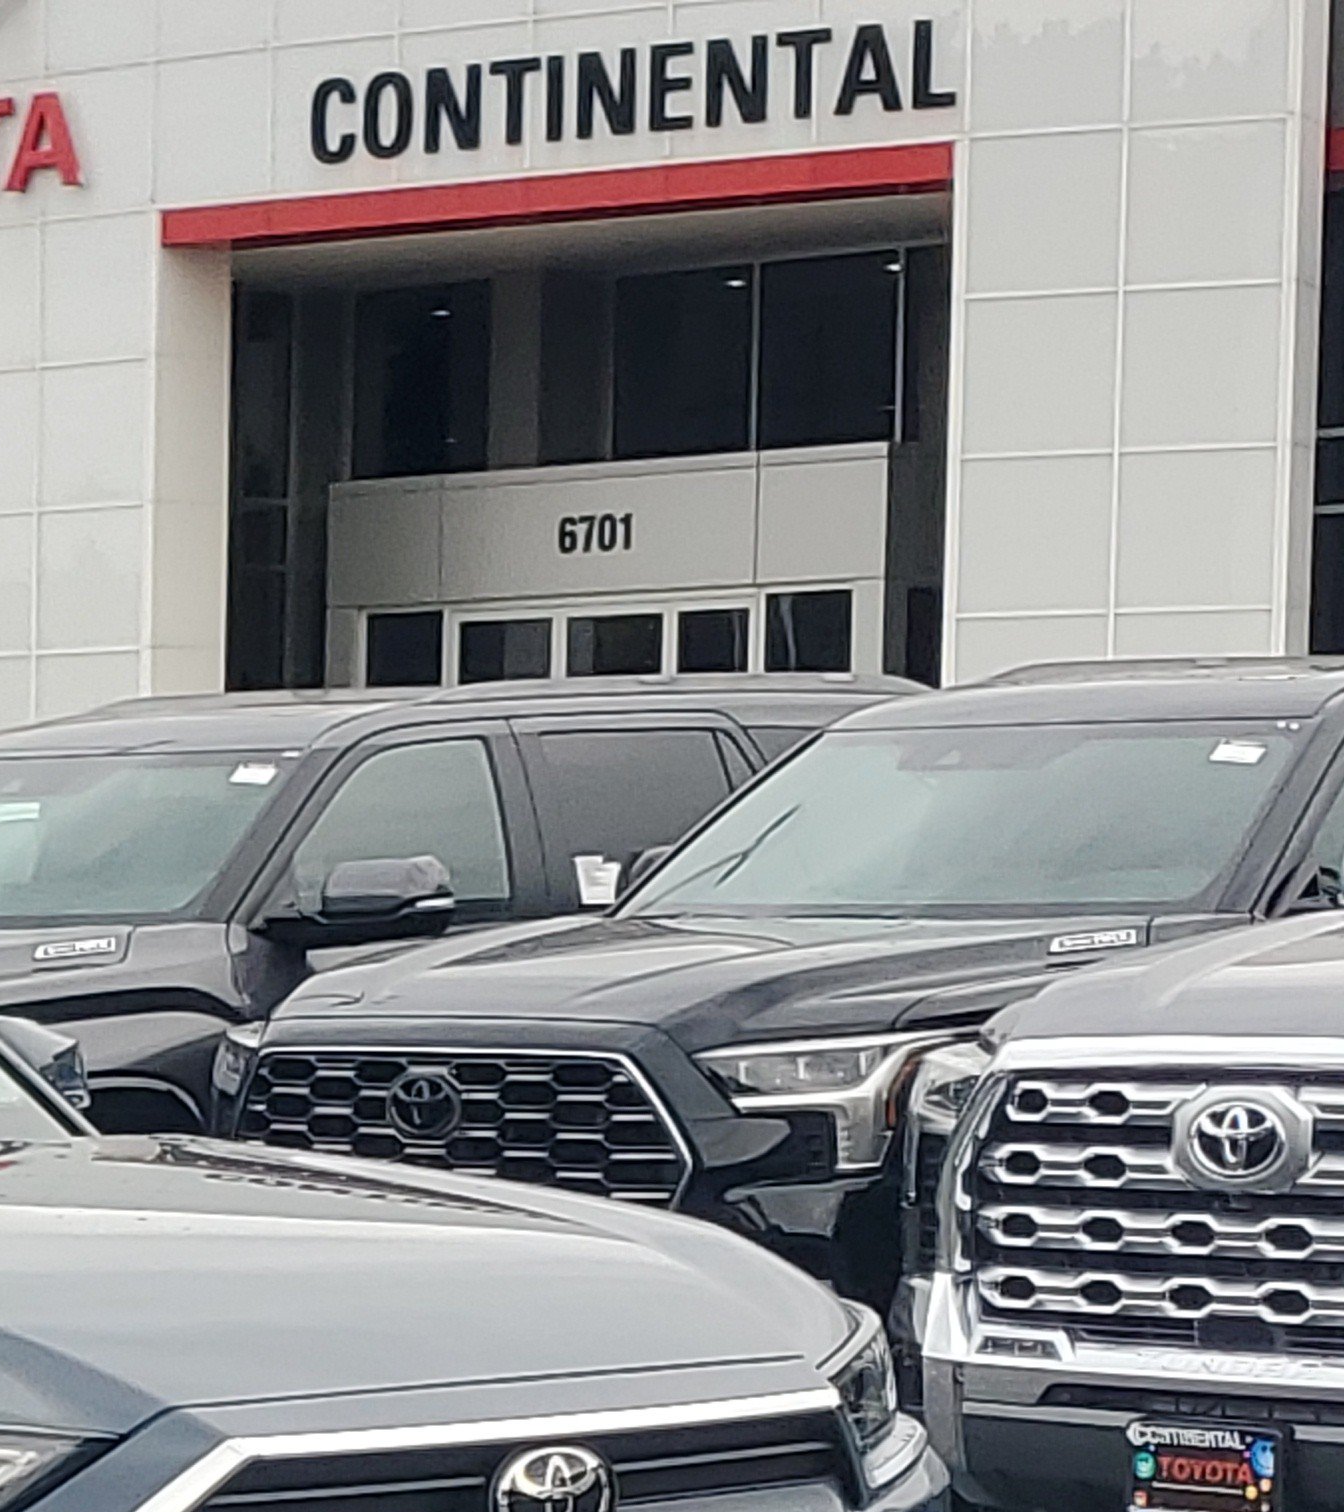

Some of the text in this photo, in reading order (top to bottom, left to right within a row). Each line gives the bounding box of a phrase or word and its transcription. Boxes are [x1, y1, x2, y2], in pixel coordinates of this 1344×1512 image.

[309, 19, 957, 165] CONTINENTAL
[557, 513, 634, 555] 6701
[1126, 1422, 1246, 1449] CONTINENTAL
[1158, 1455, 1255, 1485] TOYOTA
